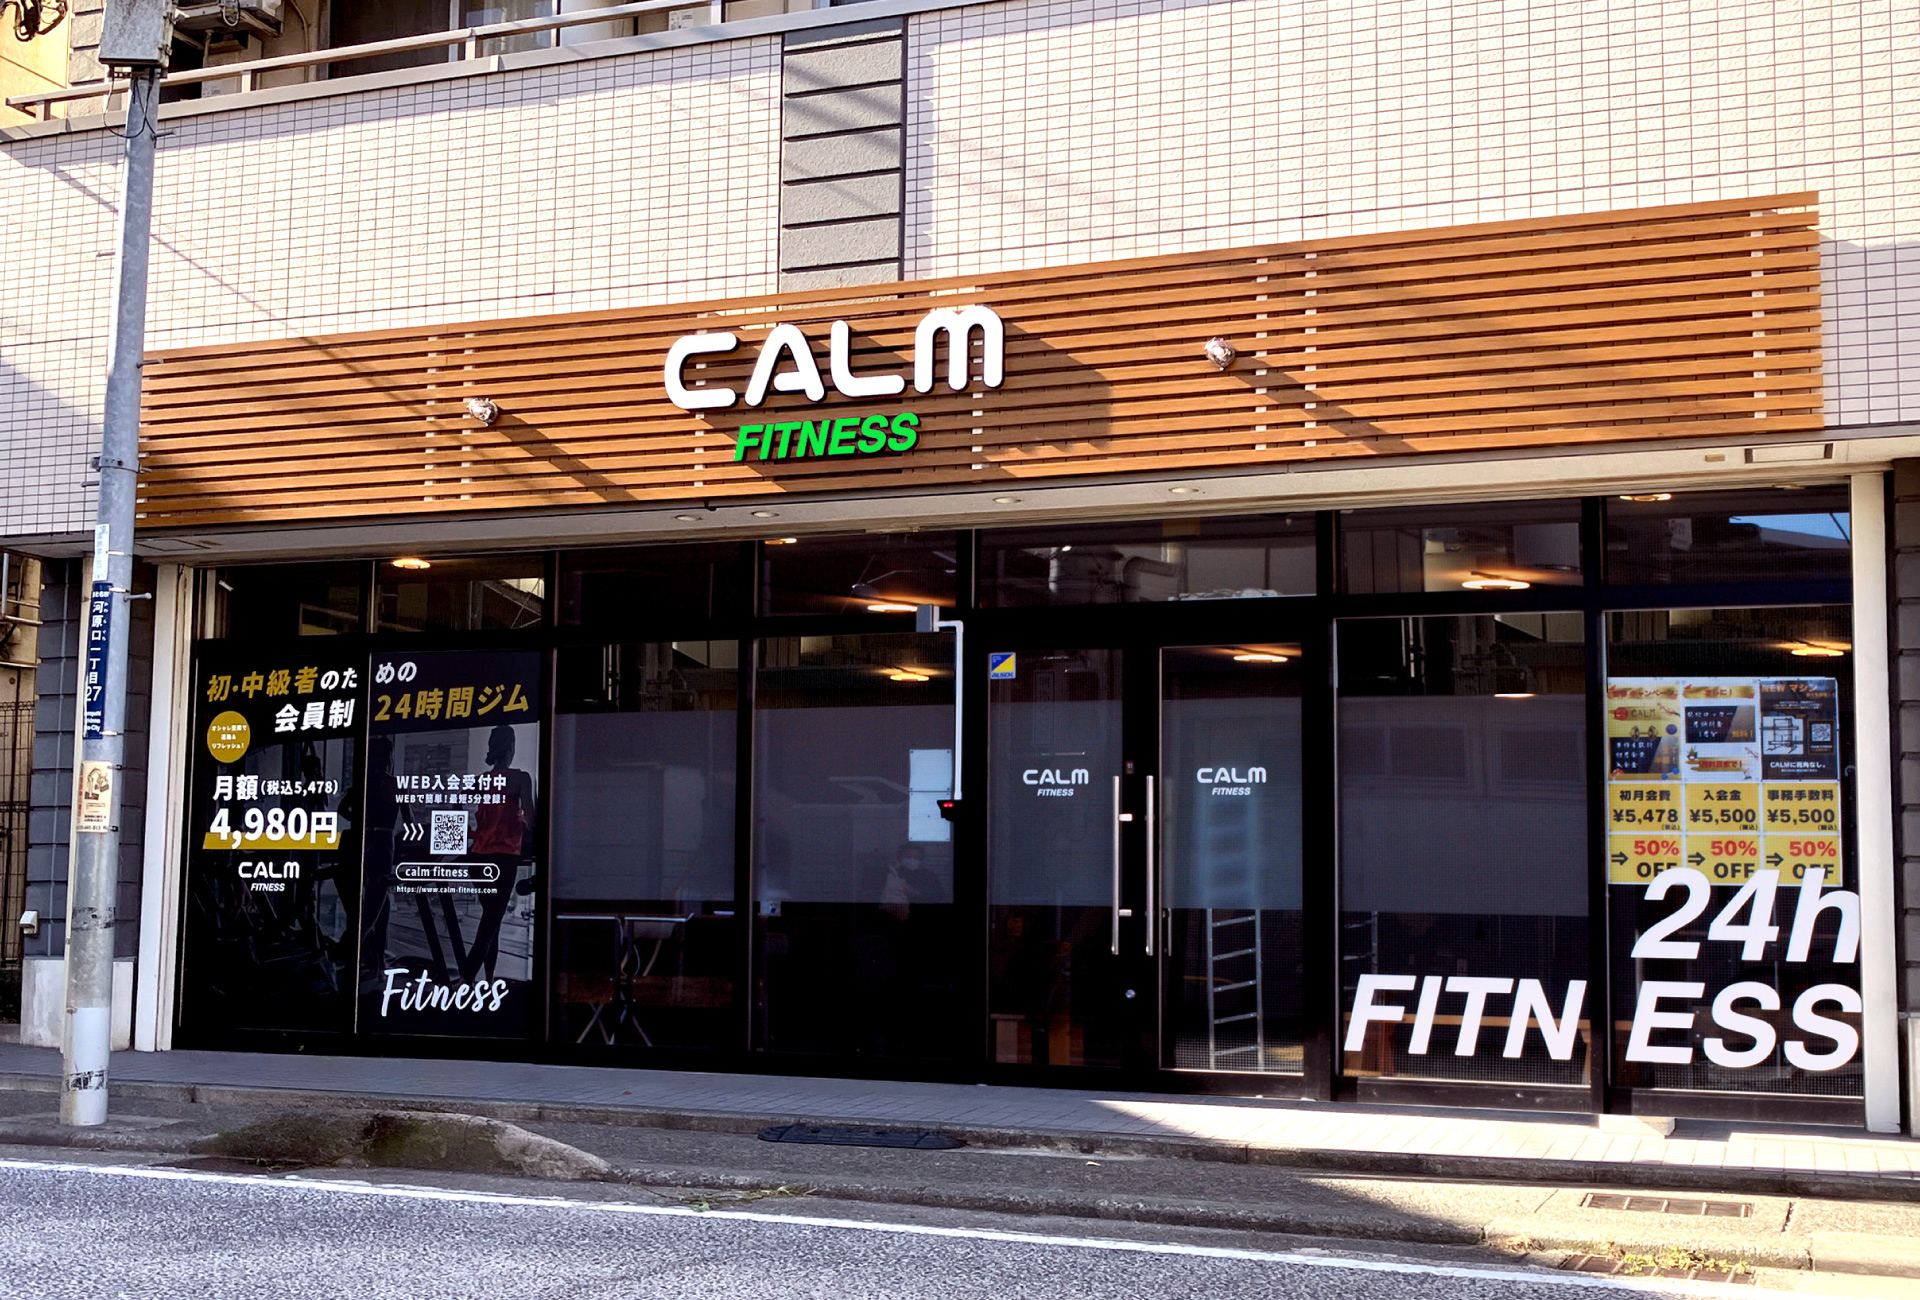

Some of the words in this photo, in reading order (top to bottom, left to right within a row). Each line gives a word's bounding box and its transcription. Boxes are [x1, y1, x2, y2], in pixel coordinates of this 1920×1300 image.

[664, 304, 1004, 409] CALM
[734, 412, 919, 462] FITNESS
[375, 661, 418, 684] めの
[86, 685, 103, 702] 27
[1761, 684, 1787, 693] NEW
[1789, 684, 1818, 692] マシン
[274, 698, 356, 733] 会員制
[374, 683, 529, 722] 24時間ジム
[396, 774, 507, 791] WEB入会受付中
[1022, 769, 1089, 785] CALM
[1196, 767, 1267, 784] CALM
[1037, 788, 1074, 797] FITNESS
[1211, 787, 1251, 796] FITNESS
[1703, 789, 1742, 801] 入会金
[1767, 789, 1834, 801] 事務手数料
[1613, 808, 1679, 825] ¥5,478
[1689, 808, 1757, 826] ¥5,500
[1767, 808, 1836, 826] ¥5,500
[209, 807, 338, 850] 4,980円
[1633, 839, 1680, 857] 50%
[1710, 839, 1758, 857] 50%
[1789, 840, 1837, 858] 50%
[238, 861, 300, 879] CALM
[405, 867, 430, 877] calm
[433, 866, 469, 878] fitness
[1713, 862, 1756, 879] OFF
[250, 882, 285, 892] FITNESS
[396, 885, 498, 894] https://www.calm-fitness.com
[1630, 867, 1861, 963] 24h
[381, 968, 509, 1017] Fitness
[1344, 973, 1588, 1062] FITN
[1625, 980, 1862, 1072] ESS
